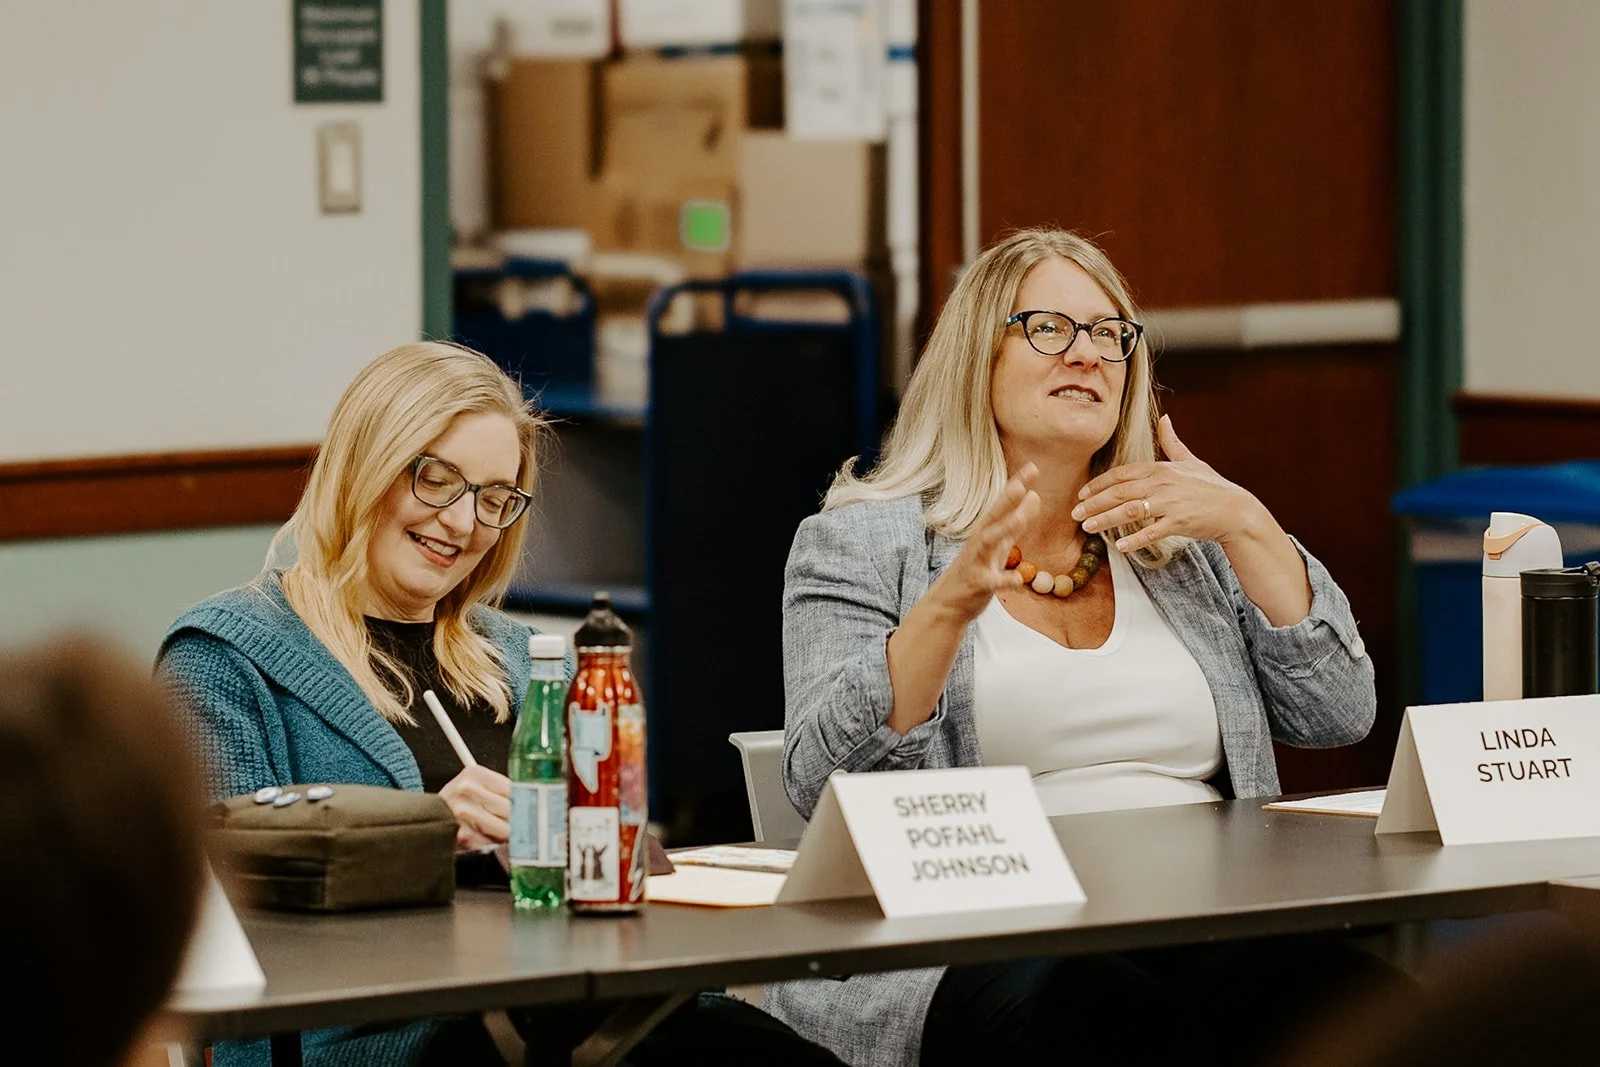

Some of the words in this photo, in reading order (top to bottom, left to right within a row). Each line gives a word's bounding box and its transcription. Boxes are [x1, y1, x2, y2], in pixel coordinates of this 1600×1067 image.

[1480, 727, 1556, 750] LINDA
[1477, 757, 1572, 782] STUART
[894, 791, 987, 817] SHERRY
[906, 824, 1006, 849] POFAHL
[911, 853, 1030, 882] JOHNSON
